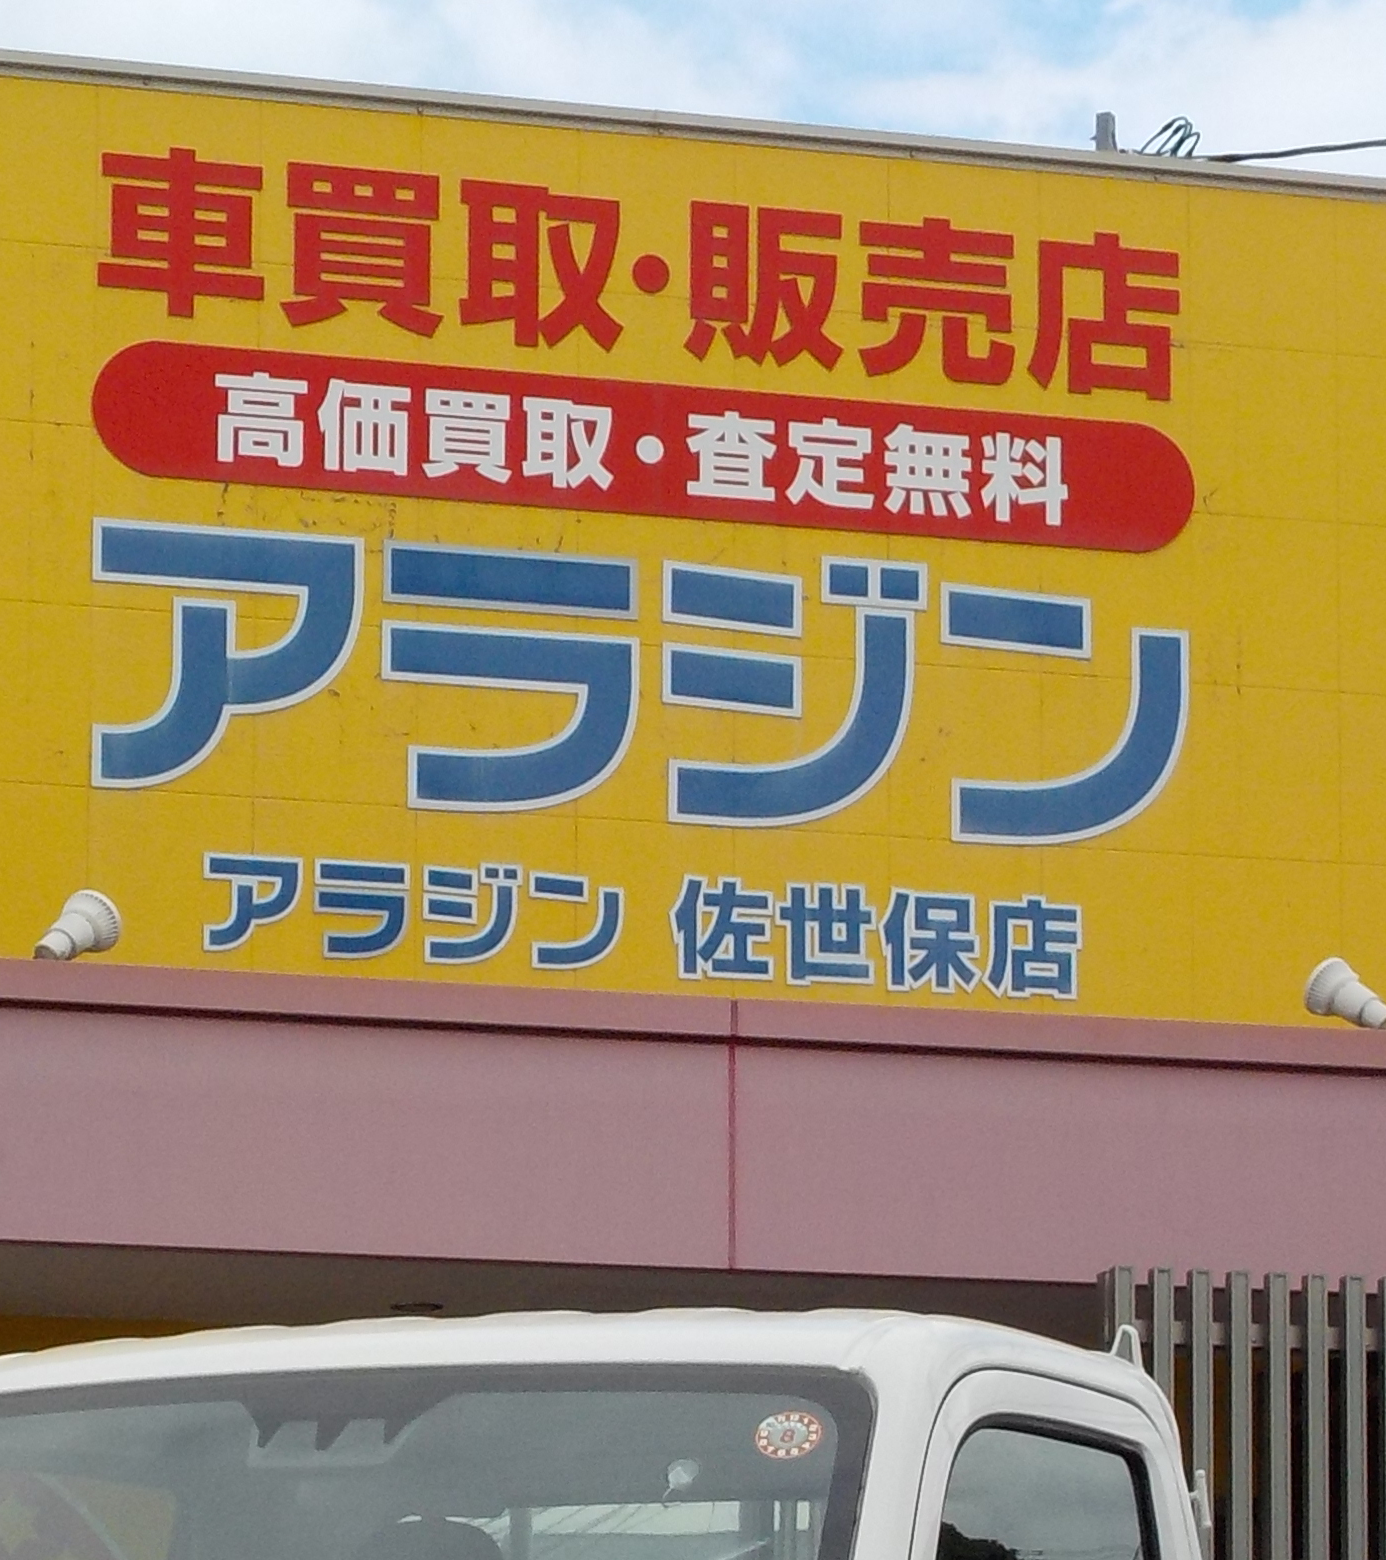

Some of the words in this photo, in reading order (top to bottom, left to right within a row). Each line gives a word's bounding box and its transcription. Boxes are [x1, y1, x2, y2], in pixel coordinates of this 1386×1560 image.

[97, 147, 1180, 402] 車買取・販売店
[215, 370, 1070, 527] 高価買取・査定無料
[93, 516, 1189, 845] アラジン
[203, 851, 625, 969] アラジン
[668, 874, 1083, 1000] 佐世保店
